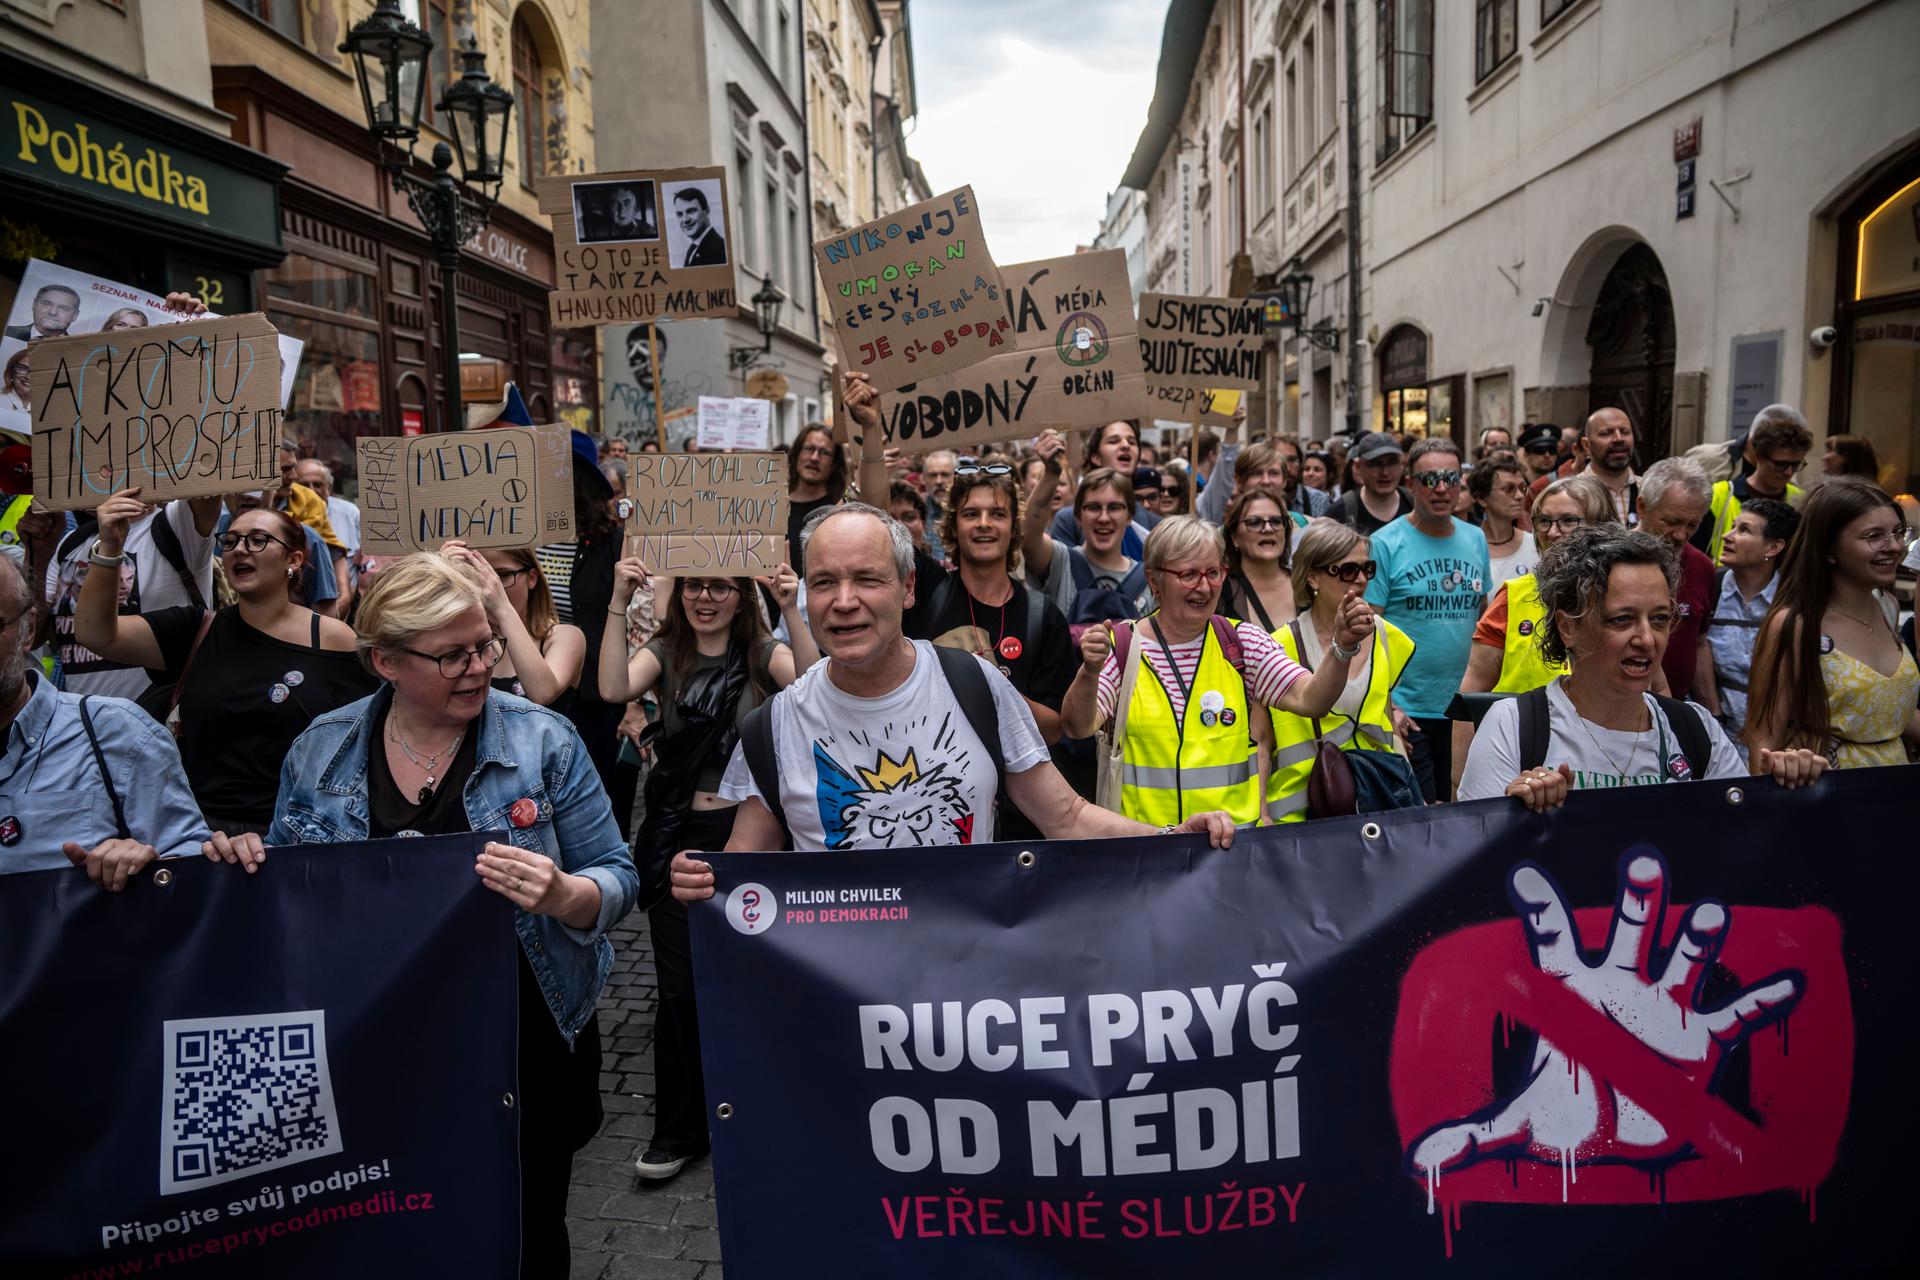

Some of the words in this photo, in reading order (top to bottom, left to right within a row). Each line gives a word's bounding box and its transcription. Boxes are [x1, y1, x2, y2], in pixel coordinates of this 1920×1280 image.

[12, 102, 209, 215] Pohádka
[488, 233, 528, 271] ORLICE
[564, 247, 598, 271] CO
[607, 248, 631, 270] TO
[642, 247, 660, 266] JE
[838, 240, 965, 297] UMORAN
[91, 282, 141, 303] SEZNAM:
[195, 276, 224, 310] 32
[633, 270, 668, 288] ZA
[1055, 284, 1108, 314] MÉDIA
[558, 292, 656, 322] HNUSNOU
[846, 283, 919, 329] ČESKÝ
[901, 275, 999, 326] ROZHLAS
[859, 335, 894, 365] JE
[903, 316, 1010, 363] SLOBODAN
[39, 357, 81, 422] A
[104, 332, 240, 415] KOMU
[1063, 369, 1114, 395] OBČAN
[854, 356, 1039, 446] VOBODNÝ
[35, 415, 113, 499] TÍM
[127, 405, 282, 489] PROSPĚJETE
[417, 439, 519, 486] MÉDIA
[636, 455, 745, 489] ROZMOHL
[751, 457, 781, 486] SE
[420, 499, 525, 542] NEDÁME
[635, 491, 693, 526] NÁM
[695, 489, 717, 501] TADY
[717, 490, 779, 527] TAKOVÝ
[1427, 579, 1437, 591] 19
[786, 890, 835, 904] MILION
[840, 888, 902, 902] CHVILEK
[786, 910, 815, 924] PRO
[820, 907, 908, 922] DEMOKRACII
[859, 996, 1069, 1072] RUCE
[1088, 962, 1299, 1067] PRYČ
[868, 1095, 1001, 1175] OD
[1027, 1055, 1302, 1177] MÉDIÍ
[101, 1206, 220, 1249] Připojte
[227, 1185, 285, 1216] svůj
[293, 1159, 391, 1204] podpis!
[881, 1187, 1105, 1240] VEŘEJNÉ
[1120, 1182, 1306, 1239] SLUŽBY
